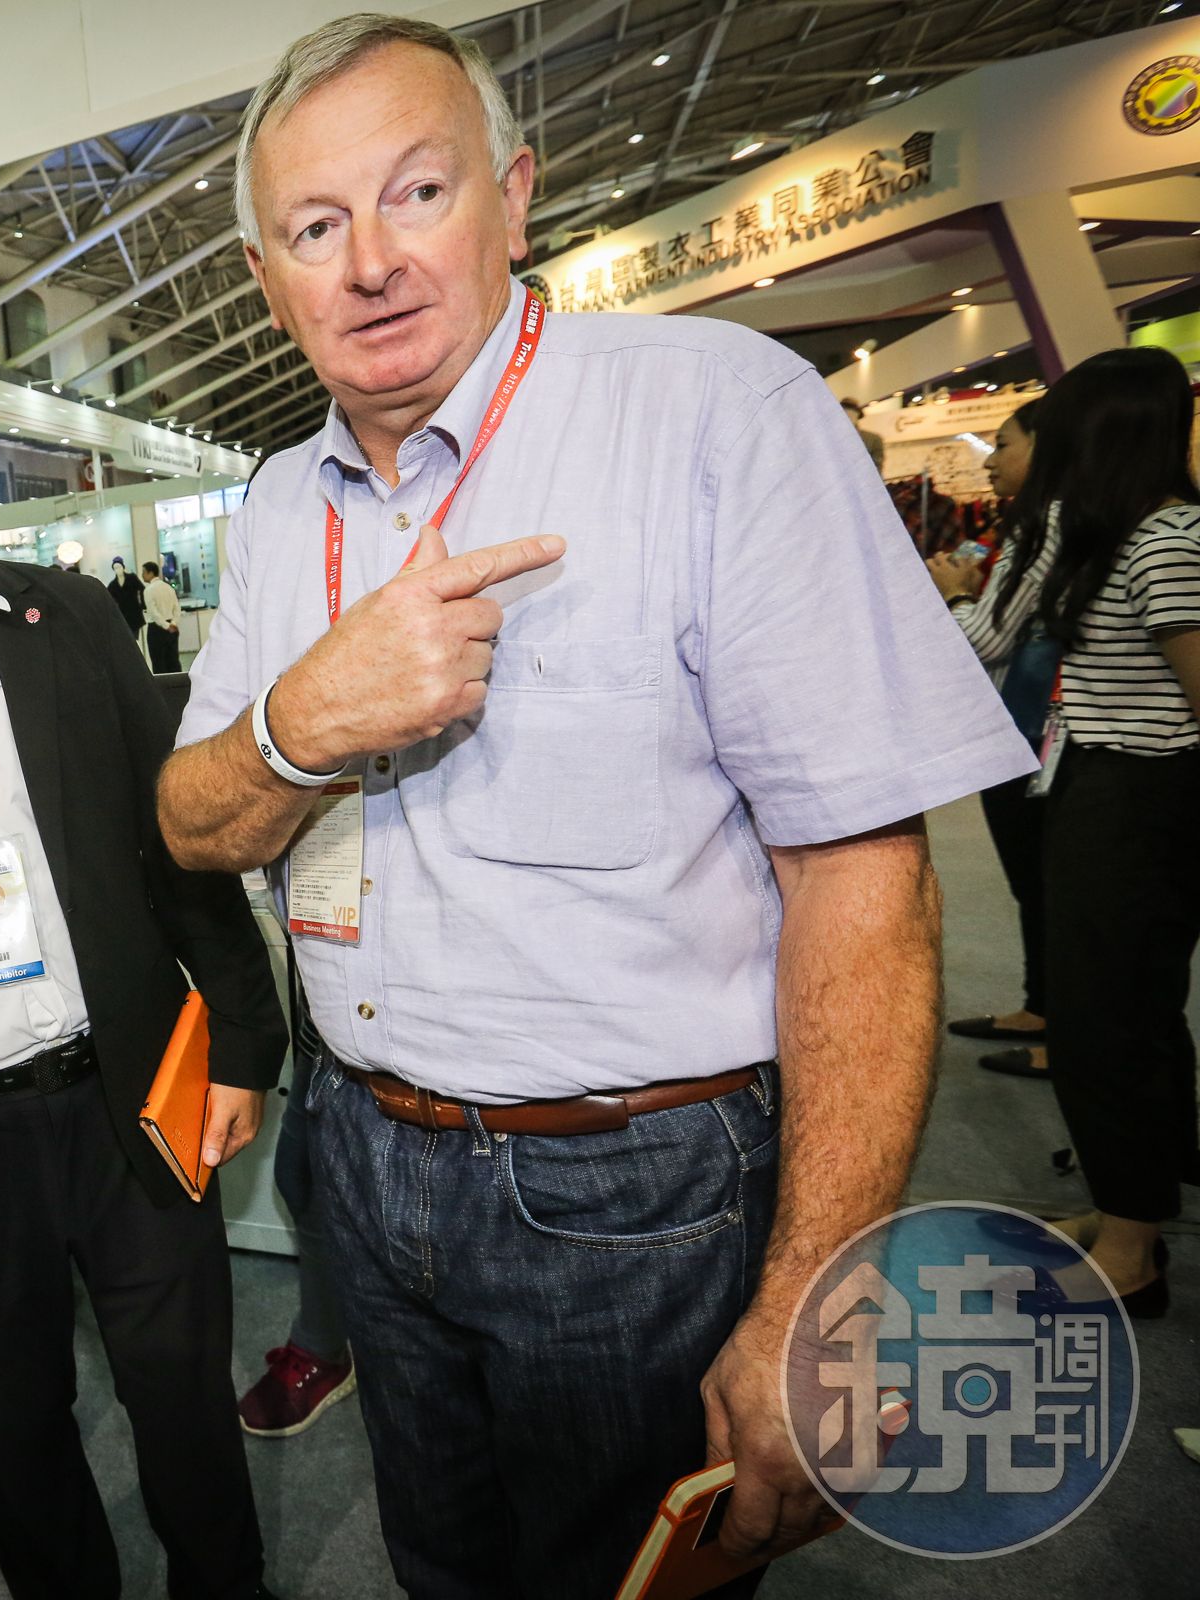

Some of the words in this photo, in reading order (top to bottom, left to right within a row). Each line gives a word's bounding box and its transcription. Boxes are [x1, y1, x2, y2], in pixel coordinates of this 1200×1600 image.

[615, 259, 686, 298] GARMENT
[690, 228, 778, 269] INDUSTRY
[784, 166, 932, 235] ASSOCIATION
[332, 905, 356, 927] VIP
[303, 923, 321, 933] Business
[322, 925, 341, 938] Meeting
